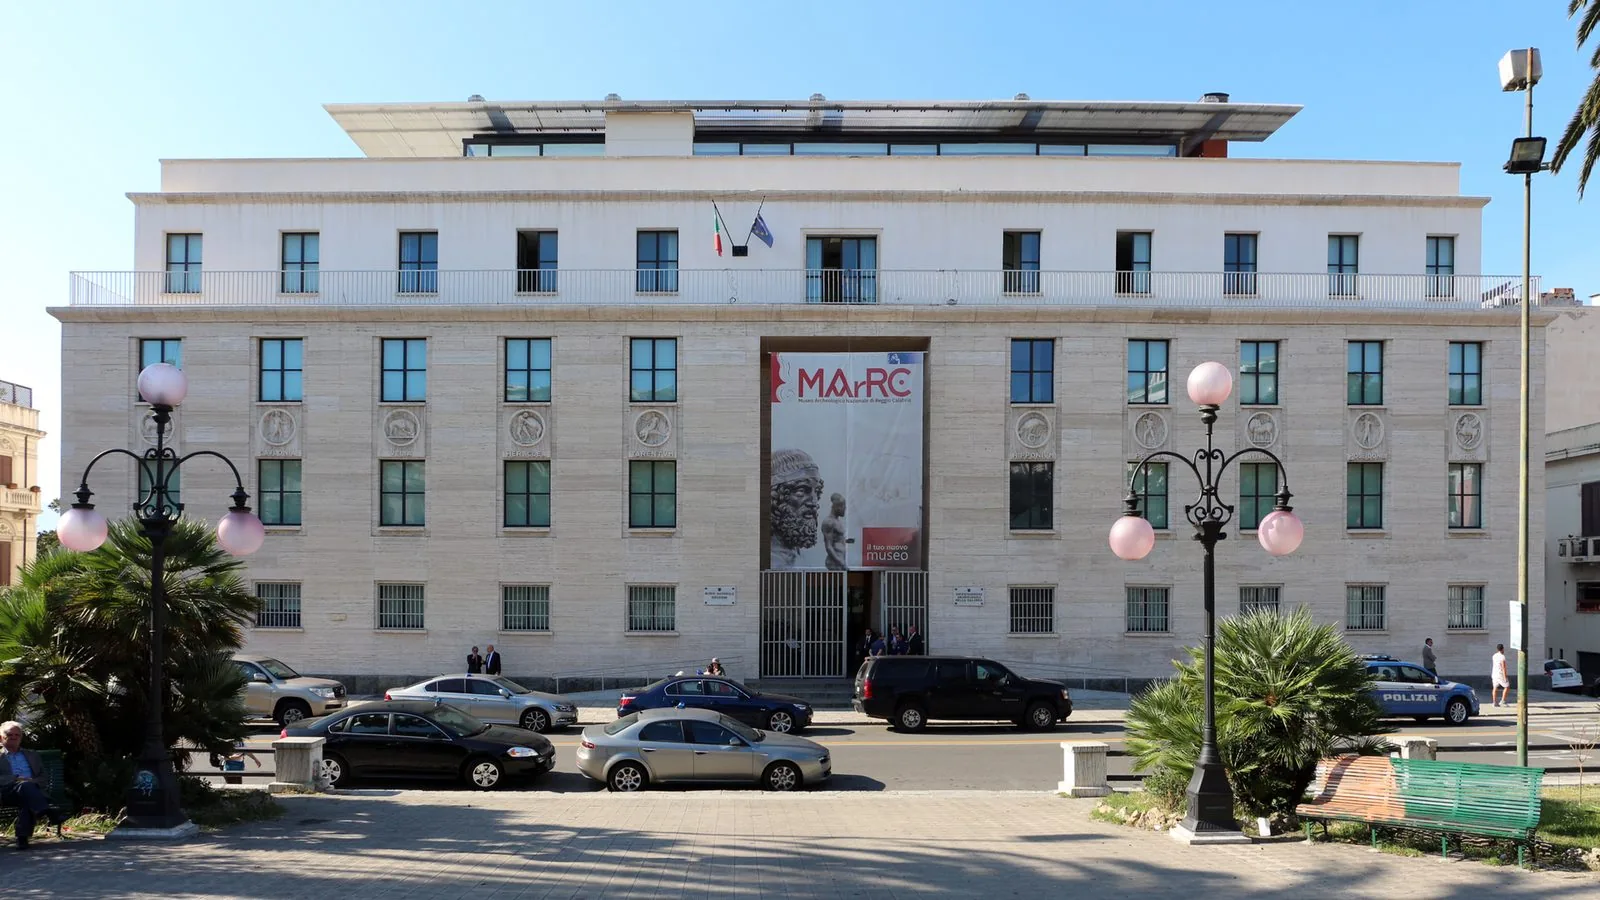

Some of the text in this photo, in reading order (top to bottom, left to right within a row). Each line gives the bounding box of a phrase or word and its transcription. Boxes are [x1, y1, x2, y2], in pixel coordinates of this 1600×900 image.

[798, 368, 912, 398] MArRC
[866, 551, 909, 561] museo
[1383, 693, 1438, 702] POLIZIA
